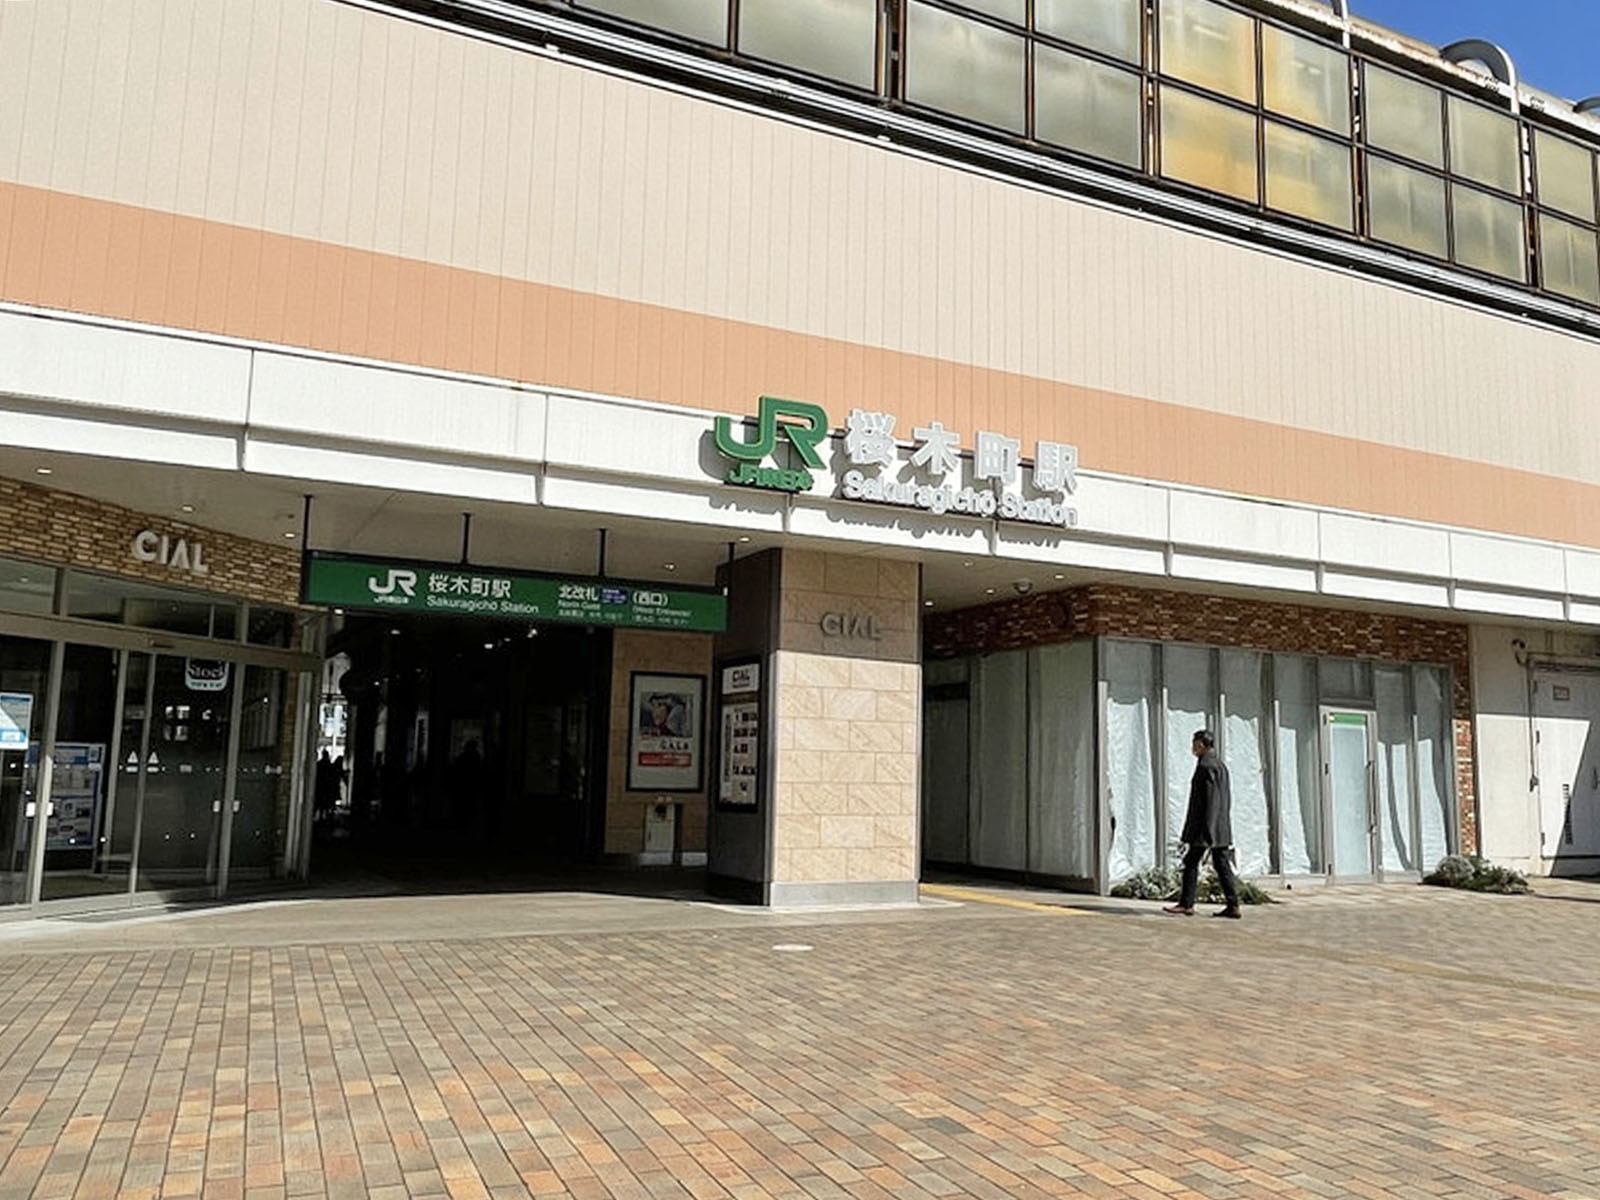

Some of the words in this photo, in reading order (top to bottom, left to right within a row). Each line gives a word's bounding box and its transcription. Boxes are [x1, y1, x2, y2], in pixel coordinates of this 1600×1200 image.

[714, 395, 828, 470] JR
[845, 408, 1079, 494] 桜木町駅
[998, 491, 1079, 527] Station
[134, 530, 208, 571] CIAL
[368, 569, 418, 597] JR
[428, 573, 512, 599] 桜木町駅
[500, 600, 539, 614] Station
[820, 611, 882, 641] CIAL
